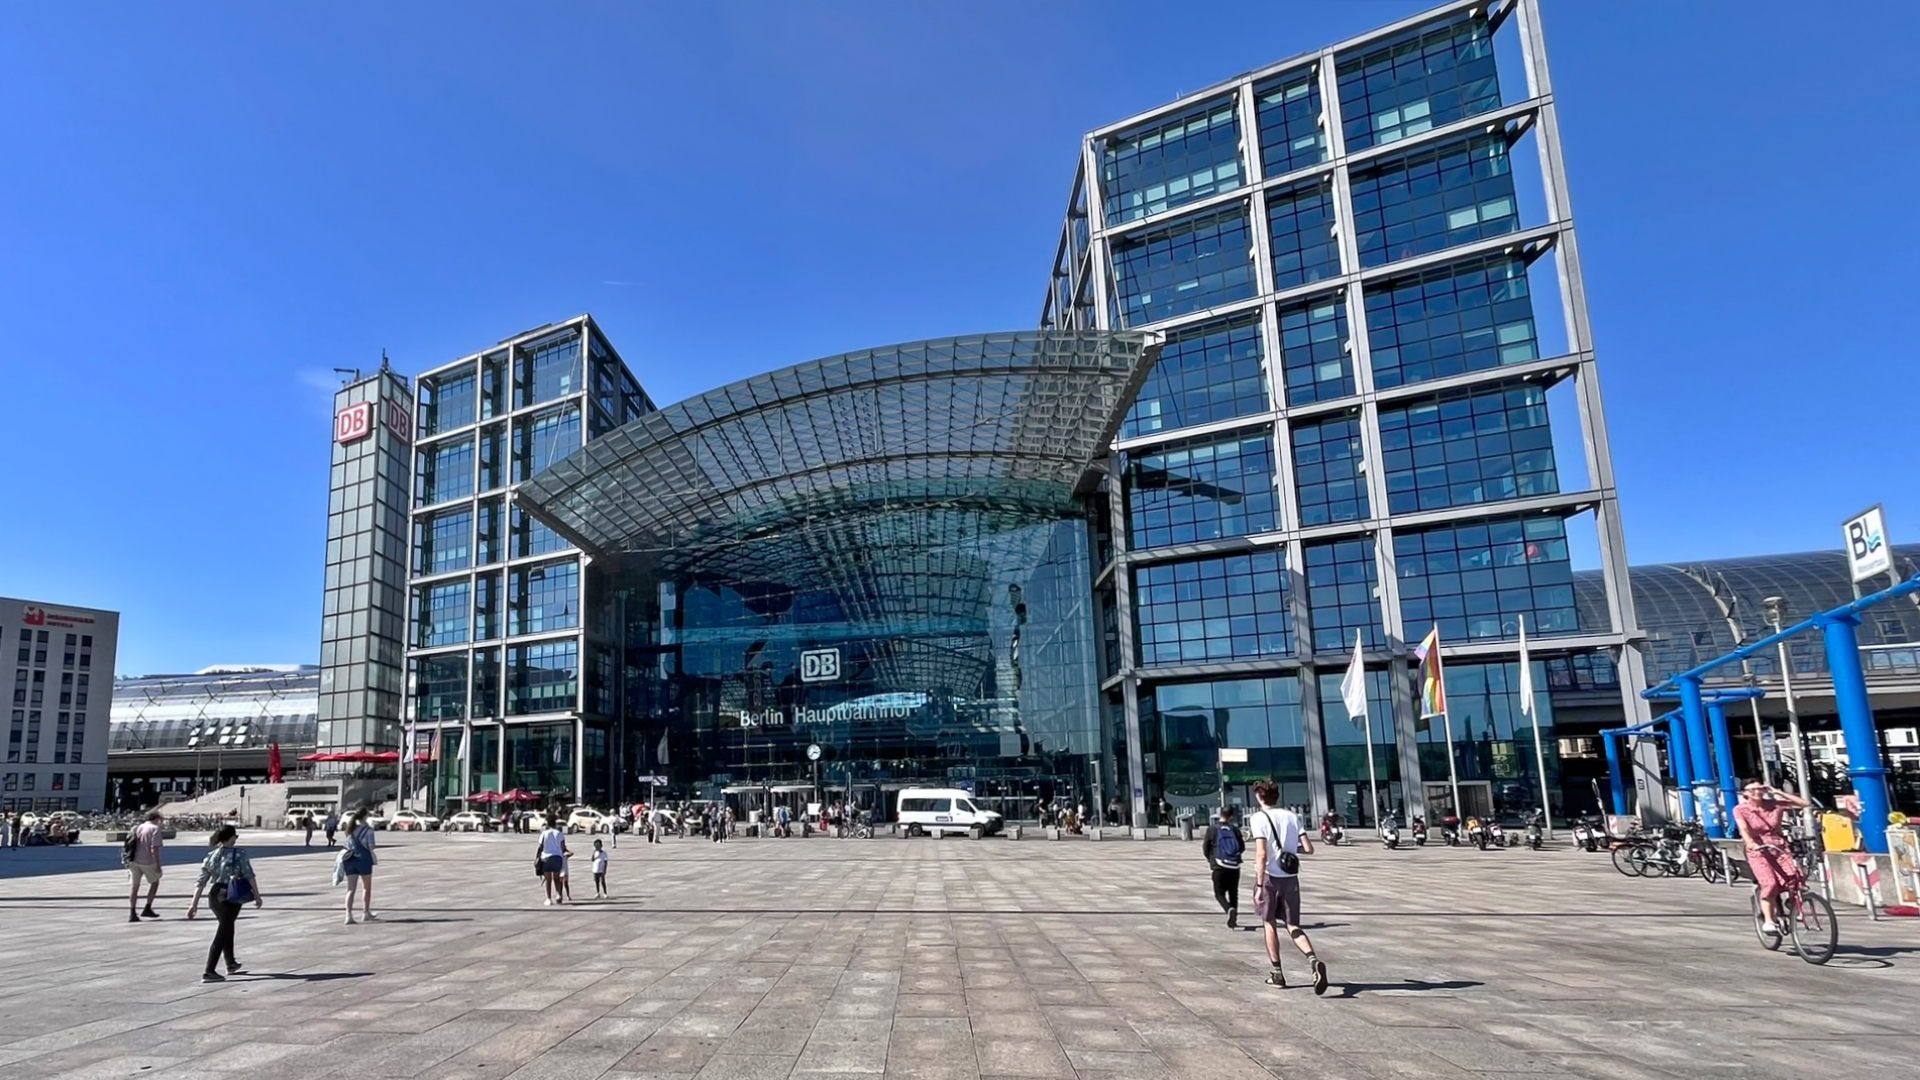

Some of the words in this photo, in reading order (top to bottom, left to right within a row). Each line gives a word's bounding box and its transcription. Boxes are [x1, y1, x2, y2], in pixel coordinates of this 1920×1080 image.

[340, 408, 365, 436] DB
[390, 404, 407, 438] DB
[805, 654, 836, 677] DB
[739, 708, 784, 727] Berlin
